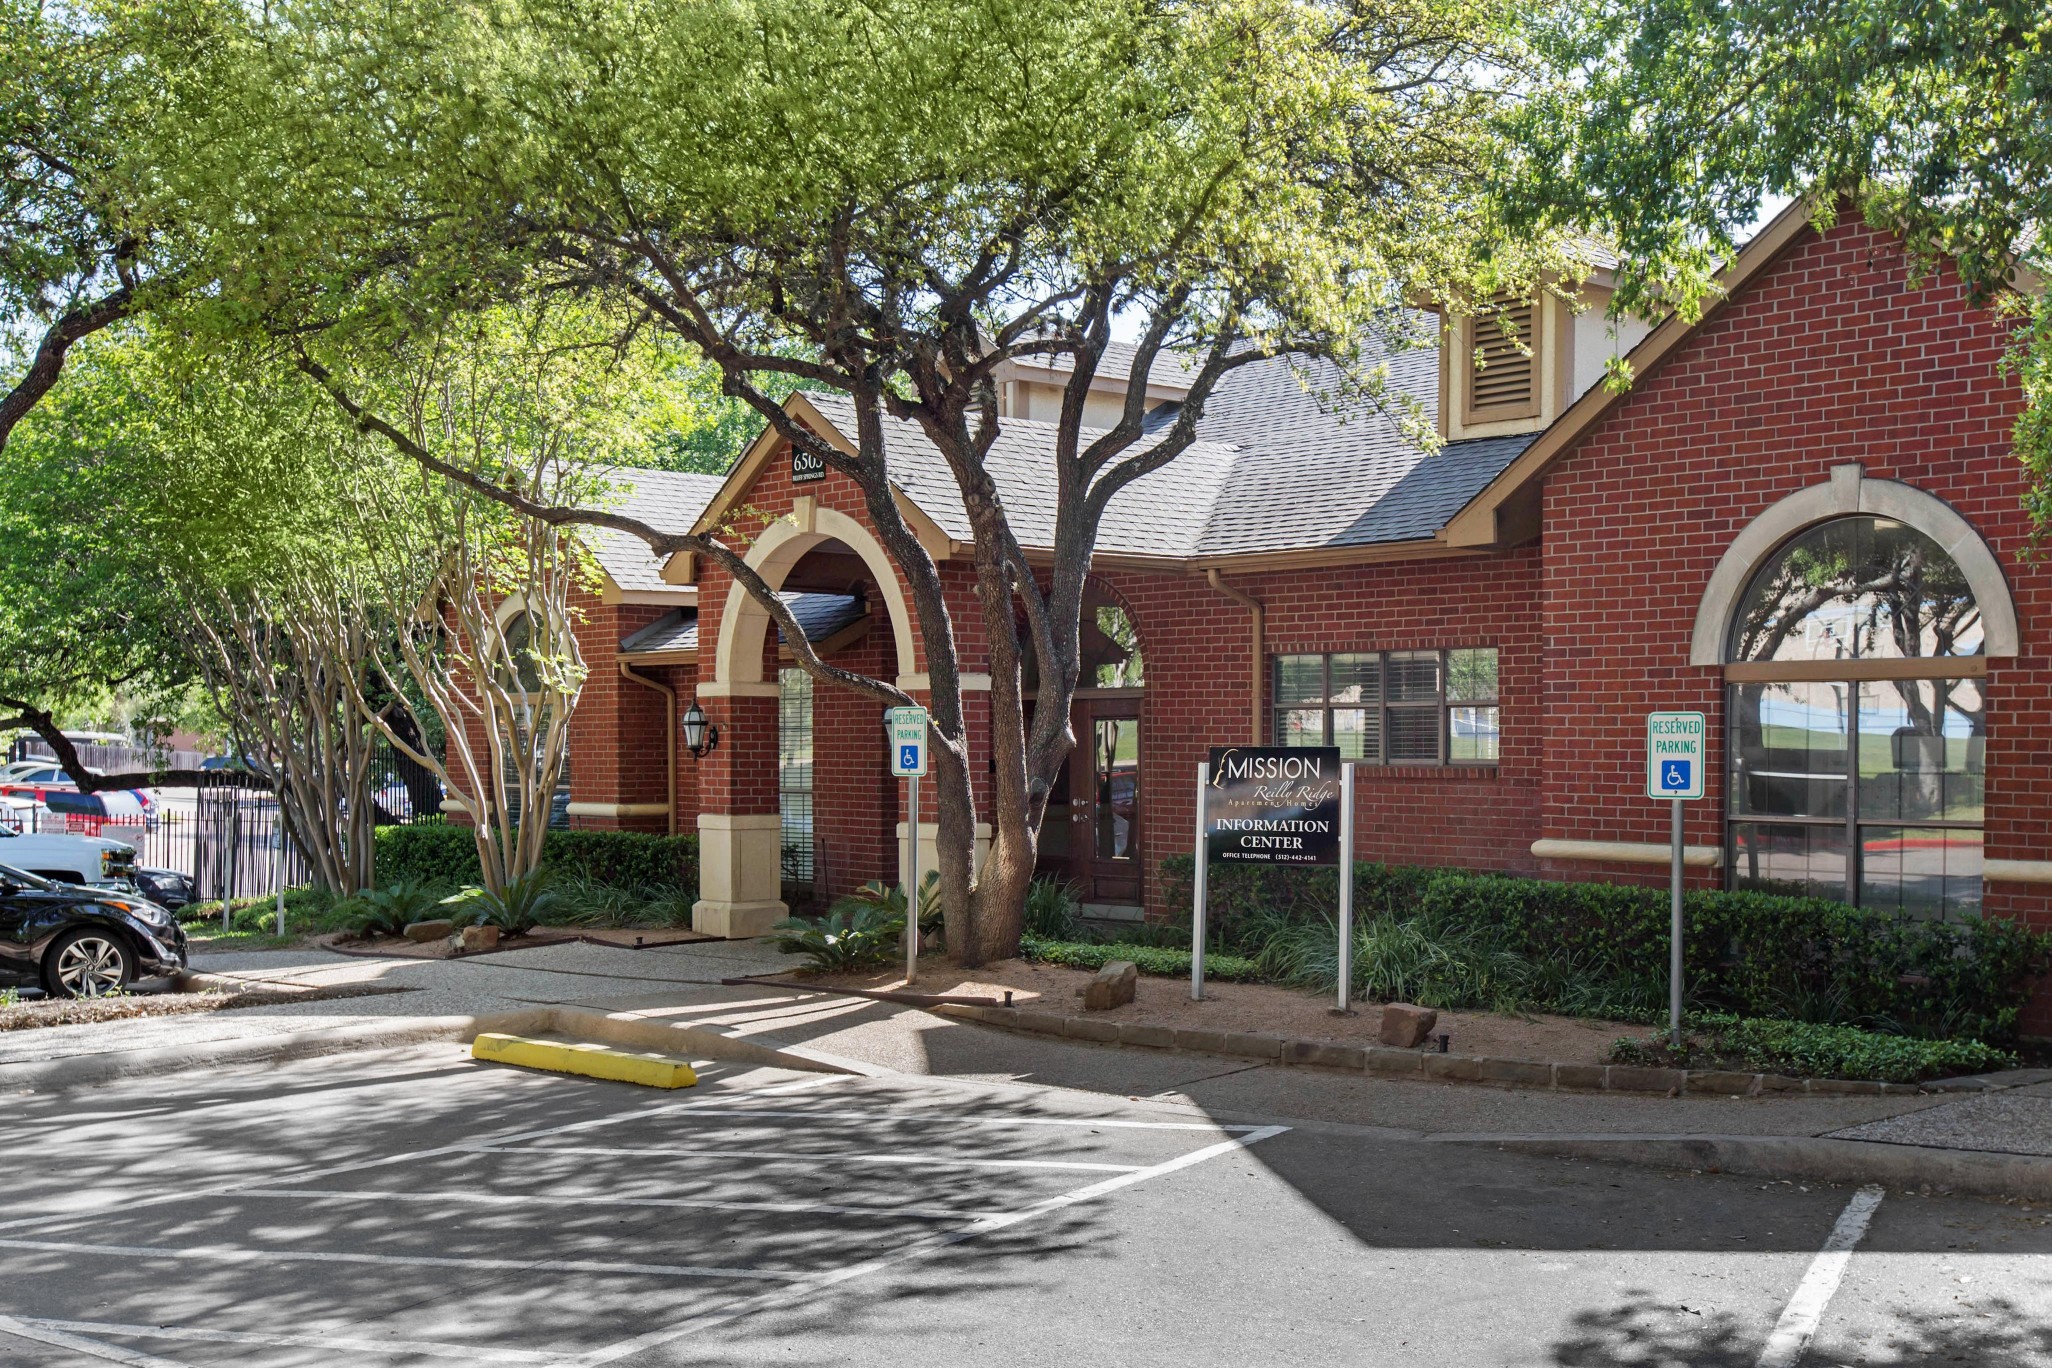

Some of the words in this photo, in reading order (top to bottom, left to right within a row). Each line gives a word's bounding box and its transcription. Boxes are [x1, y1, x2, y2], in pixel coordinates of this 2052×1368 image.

[894, 713, 924, 725] RESERVED
[1652, 720, 1700, 734] RESERVED
[897, 729, 922, 741] PARKING
[1656, 740, 1697, 754] PARKING
[1228, 757, 1321, 779] MISSION
[1253, 780, 1295, 808] Reilly
[1296, 780, 1335, 811] Ridge
[1228, 798, 1280, 808] Apartment
[1286, 799, 1318, 808] Homes
[1216, 818, 1330, 833] INFORMATION
[1240, 835, 1304, 849] CENTER
[1241, 852, 1271, 860] TELEPHONE
[1275, 853, 1317, 861] (512)-442-4141
